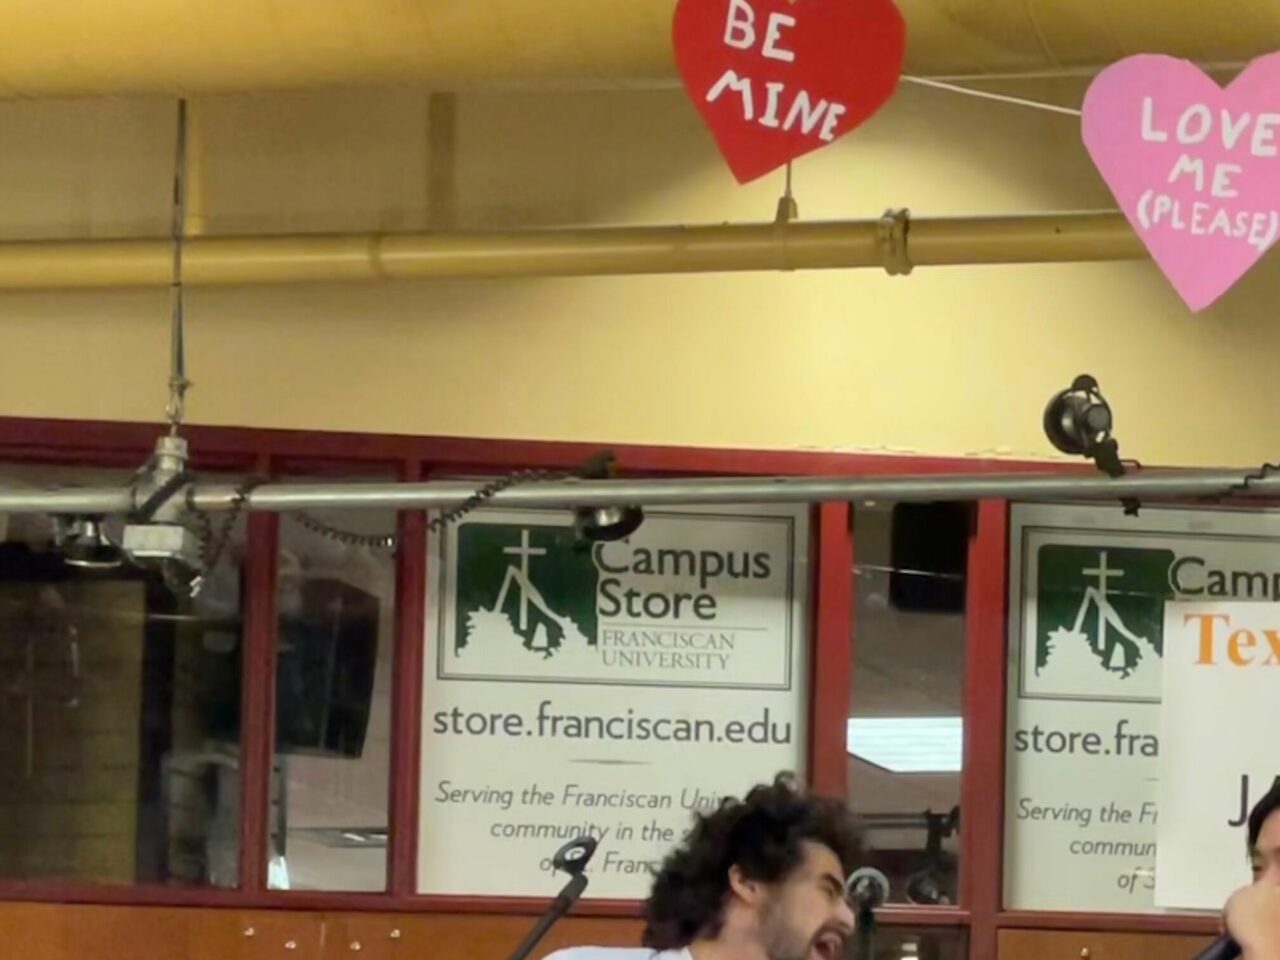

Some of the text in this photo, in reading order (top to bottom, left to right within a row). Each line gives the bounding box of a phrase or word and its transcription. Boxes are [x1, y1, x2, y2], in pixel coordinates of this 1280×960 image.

[723, 0, 796, 62] BE
[705, 69, 846, 142] MINE
[1167, 153, 1242, 197] ME
[1136, 188, 1279, 252] (PLEASE)
[594, 538, 771, 589] Campus
[599, 578, 717, 620] Store
[601, 629, 735, 650] FRANCISCAN
[601, 650, 731, 670] UNIVERSITY
[433, 700, 792, 745] store.franciscan.edu
[435, 780, 514, 810] Serving
[521, 784, 555, 805] the
[562, 784, 672, 809] Franciscan
[1016, 797, 1092, 828] Serving
[1100, 802, 1132, 823] the
[490, 820, 610, 845] community
[616, 825, 634, 841] in
[641, 820, 675, 842] the
